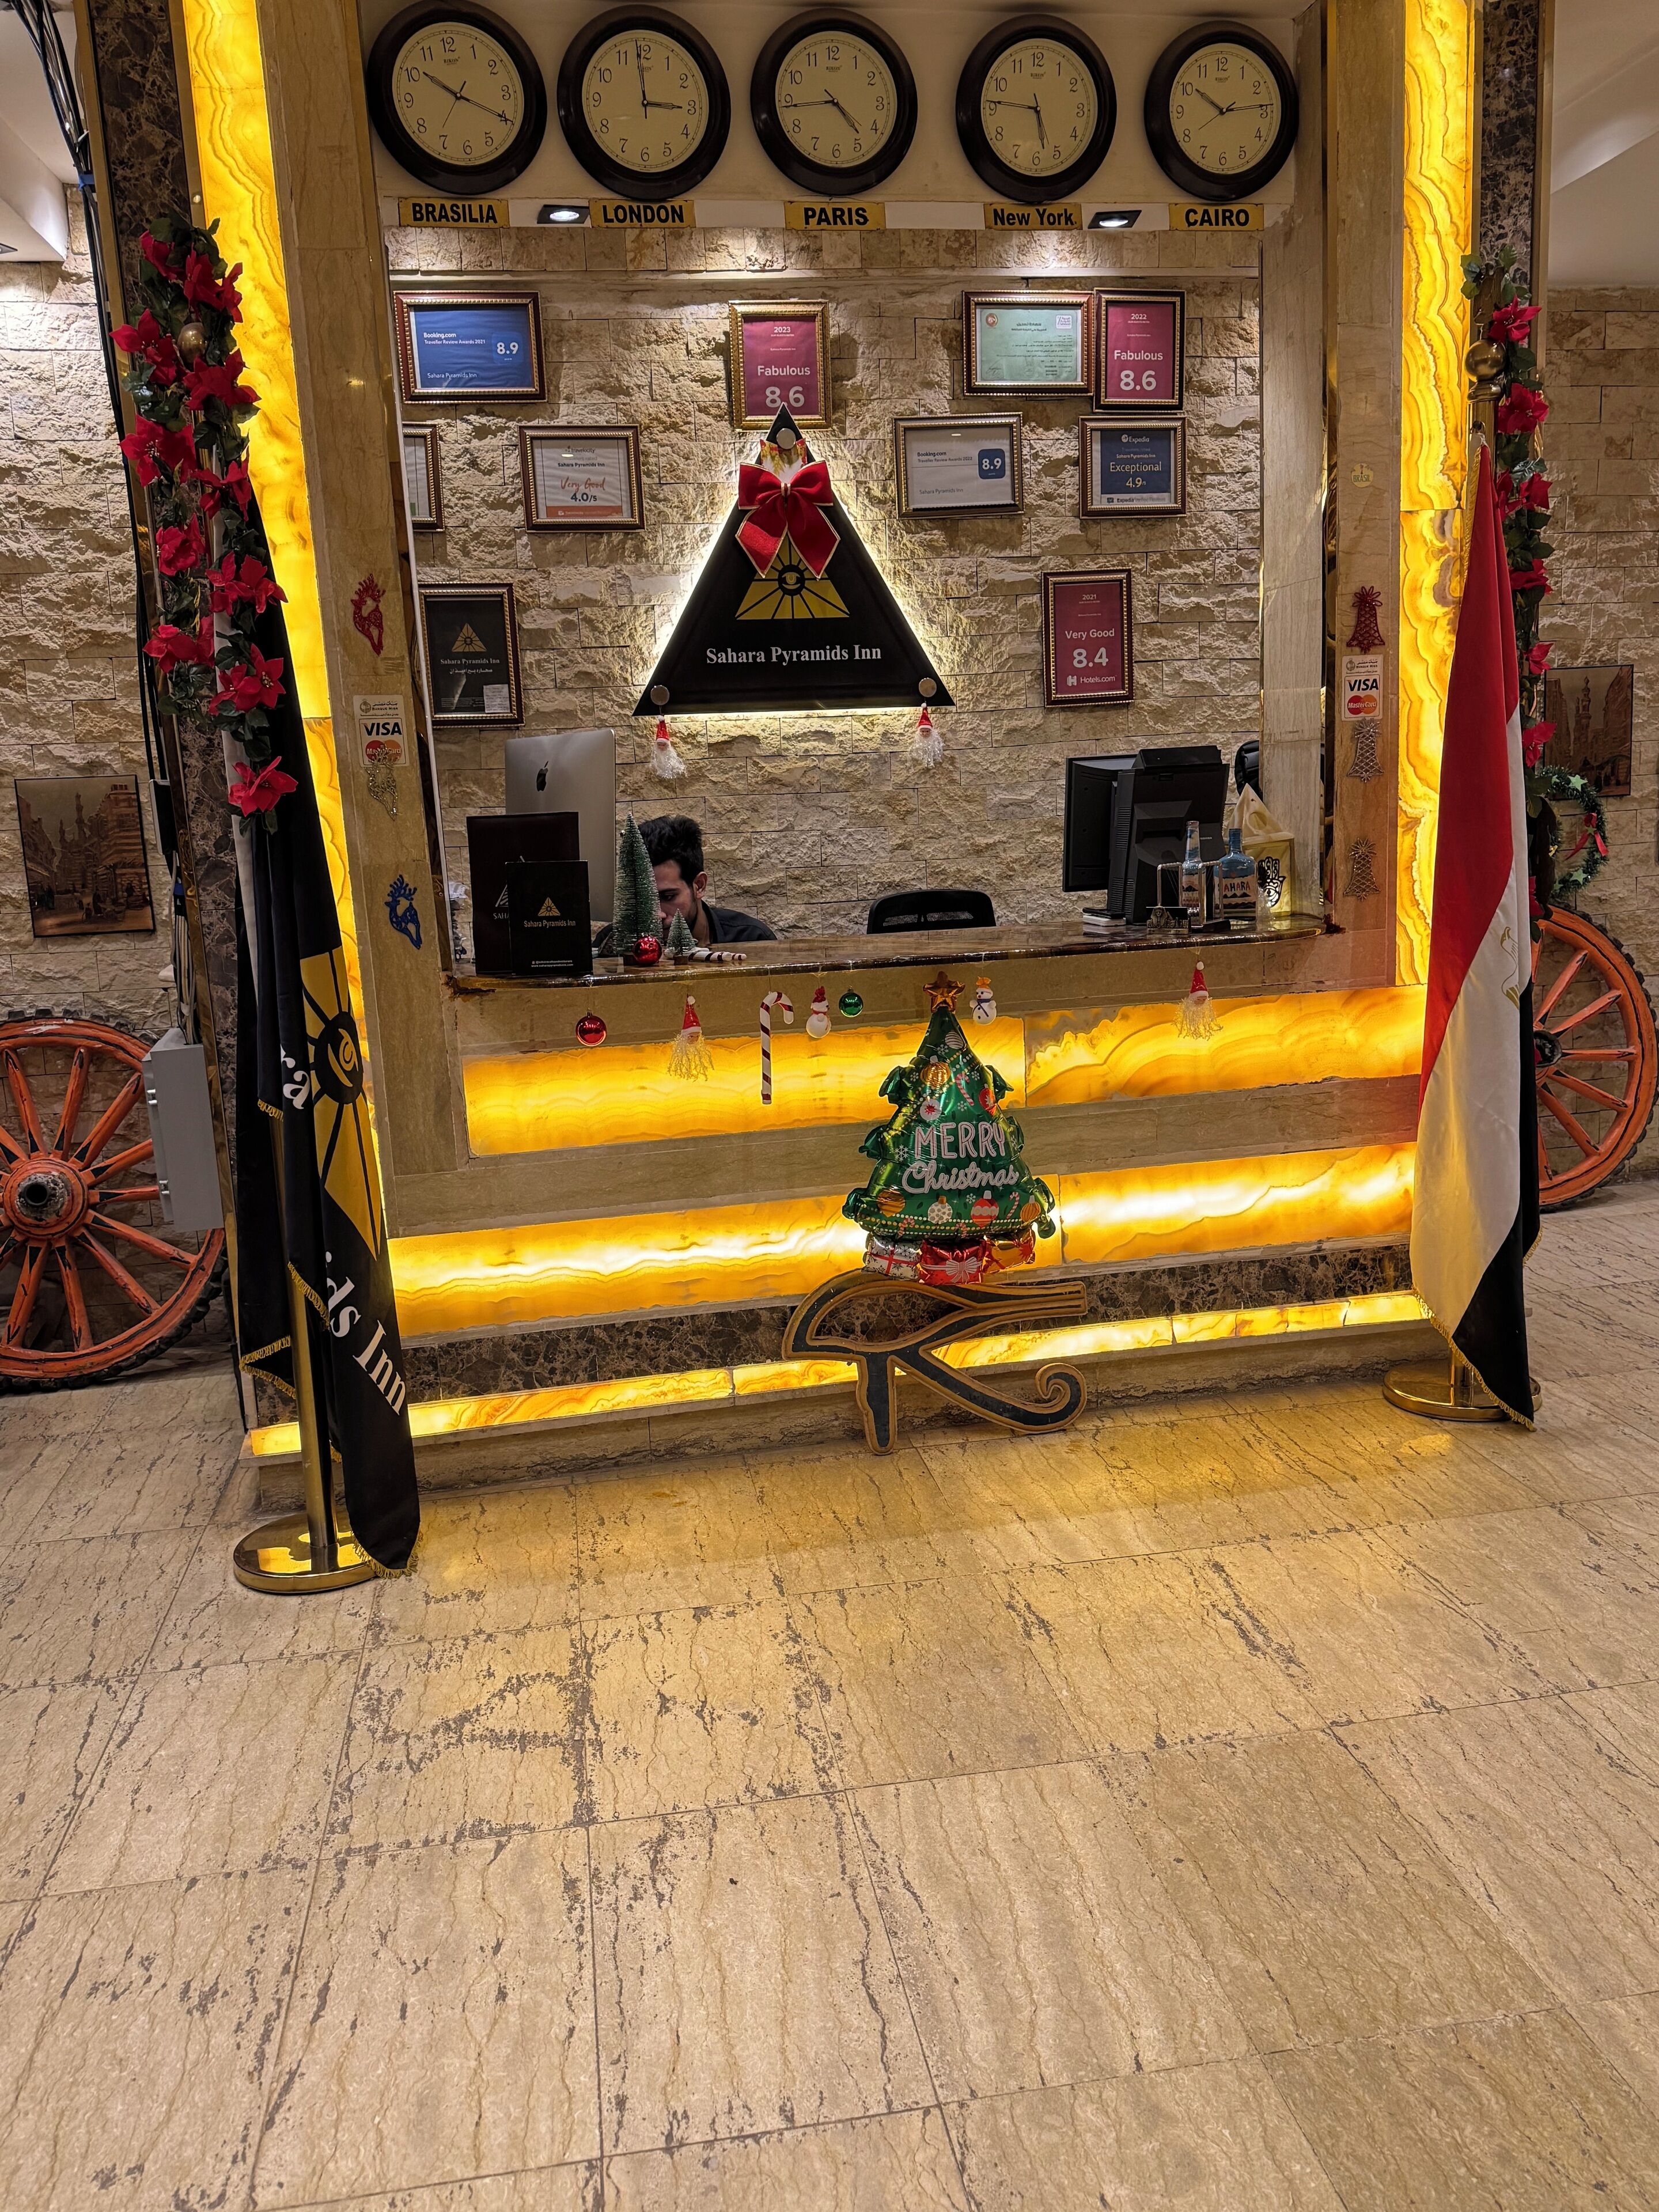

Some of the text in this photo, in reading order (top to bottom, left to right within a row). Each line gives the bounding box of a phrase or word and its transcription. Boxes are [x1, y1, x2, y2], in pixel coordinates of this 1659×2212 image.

[440, 37, 456, 53] 12
[470, 44, 476, 59] 1
[420, 46, 433, 61] 11
[616, 50, 627, 65] 11
[806, 52, 816, 67] 11
[826, 46, 839, 60] 12
[1031, 52, 1044, 67] 12
[488, 59, 498, 75] 2
[665, 55, 669, 71] 1
[853, 55, 857, 69] 1
[1012, 59, 1022, 73] 11
[1056, 62, 1060, 77] 1
[1216, 57, 1228, 71] 12
[404, 67, 420, 82] 10
[597, 67, 612, 83] 10
[788, 70, 802, 85] 10
[1197, 63, 1207, 78] 11
[1240, 65, 1244, 79] 1
[680, 73, 688, 89] 2
[868, 71, 876, 86] 2
[994, 77, 1007, 92] 10
[1070, 78, 1078, 92] 2
[501, 85, 511, 100] 3
[1180, 82, 1193, 96] 10
[1253, 81, 1261, 94] 2
[404, 93, 414, 108] 9
[593, 92, 601, 107] 9
[876, 96, 884, 111] 3
[687, 100, 696, 115] 3
[1076, 103, 1084, 118] 3
[1176, 105, 1184, 119] 9
[417, 118, 426, 133] 8
[600, 119, 609, 134] 8
[681, 124, 690, 139] 4
[793, 119, 801, 133] 8
[870, 119, 879, 134] 4
[485, 131, 493, 146] 5
[995, 126, 1003, 141] 8
[1070, 126, 1078, 141] 4
[1183, 128, 1191, 142] 8
[1255, 127, 1263, 142] 4
[440, 135, 448, 150] 7
[463, 140, 472, 155] 6
[619, 138, 628, 153] 7
[663, 142, 671, 157] 5
[811, 137, 819, 151] 7
[854, 138, 861, 152] 5
[641, 147, 649, 162] 6
[832, 144, 840, 158] 6
[1013, 145, 1020, 158] 7
[1032, 151, 1040, 166] 6
[1053, 145, 1060, 160] 5
[1200, 146, 1207, 159] 7
[1219, 152, 1226, 165] 6
[1238, 146, 1246, 160] 5
[412, 203, 498, 224] BRASILIA
[603, 205, 684, 224] LONDON
[804, 207, 869, 226] PARIS
[994, 209, 1031, 225] New
[1185, 209, 1249, 227] CAIRO
[497, 342, 518, 354] 8.9
[1114, 350, 1164, 360] Fabulous
[757, 365, 810, 376] Fabulous
[1120, 370, 1157, 391] 8.6
[982, 458, 1002, 470] 8.9
[1110, 461, 1161, 474] Exceptional
[560, 476, 605, 493] Very Good
[1353, 474, 1371, 482] BRASIL
[570, 493, 597, 502] 4.0/5
[1065, 628, 1115, 640] Very Good
[706, 645, 881, 666] Sahara Pyramids Inn
[1073, 647, 1109, 668] 8.4
[1080, 676, 1115, 684] Hotels.com
[1348, 679, 1378, 691] VISA
[363, 722, 402, 736] VISA
[1218, 880, 1251, 892] AHARA
[543, 920, 566, 928] Pyramids
[915, 1122, 1005, 1160] MERRY
[902, 1160, 1019, 1194] Christmas
[353, 1320, 406, 1416] Inn
